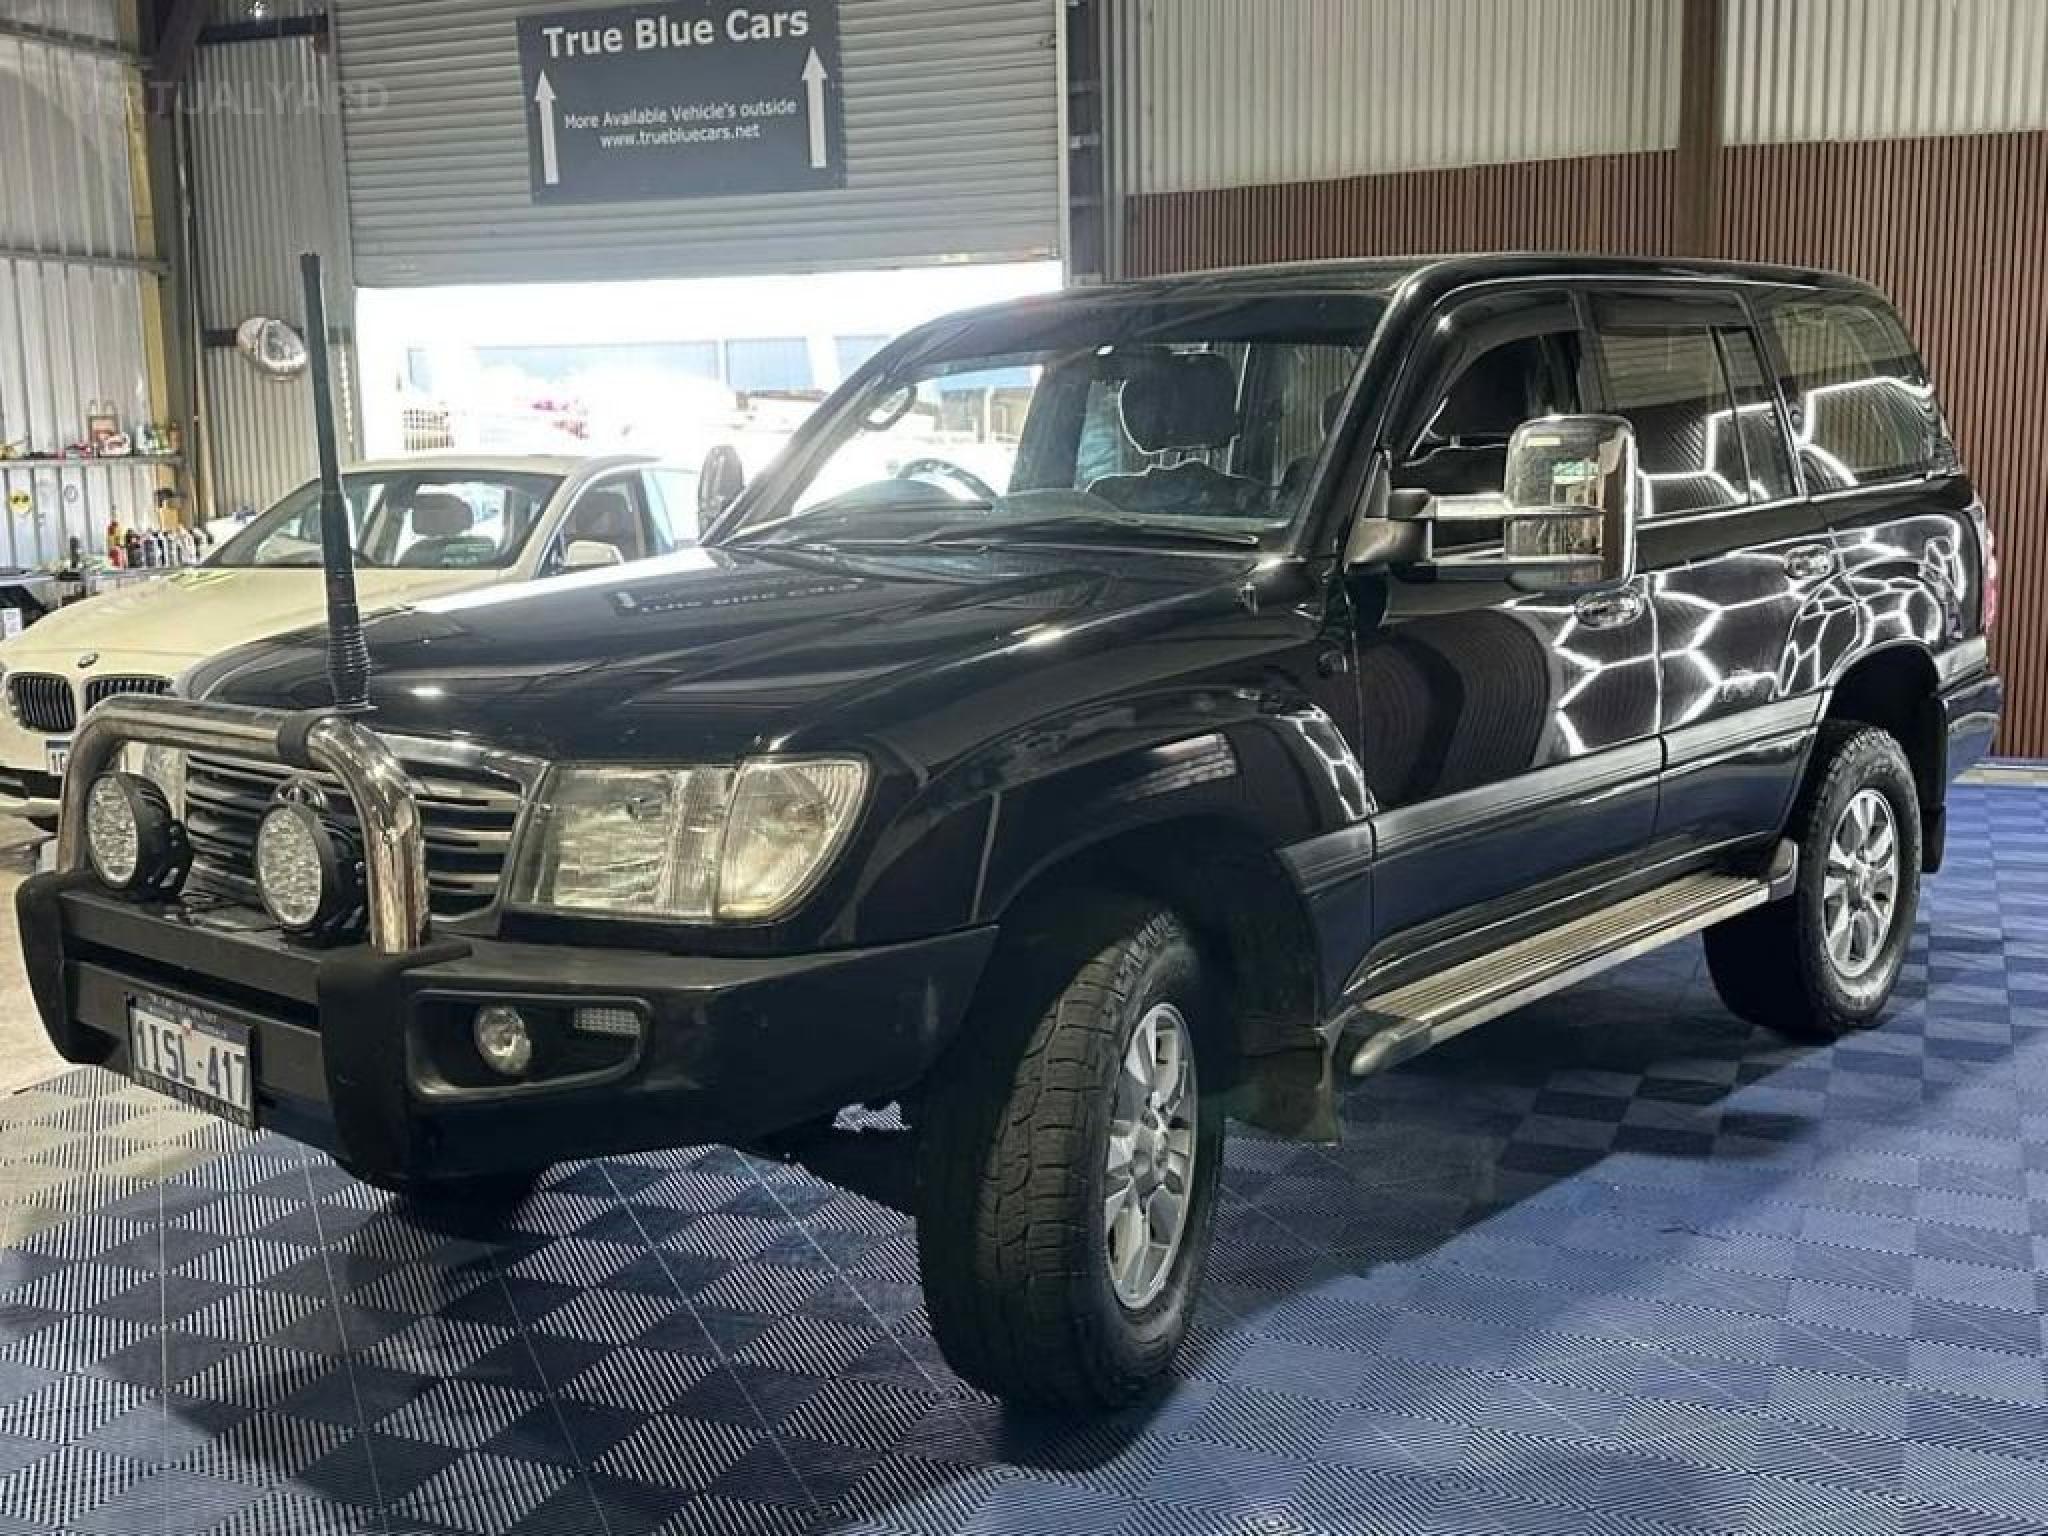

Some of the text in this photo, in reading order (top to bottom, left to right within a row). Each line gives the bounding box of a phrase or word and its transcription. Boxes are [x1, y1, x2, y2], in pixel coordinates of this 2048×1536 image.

[542, 9, 809, 58] True Blue Cars
[564, 97, 797, 129] More Available Vehicle's outside
[600, 123, 761, 149] www.truebluecars.net
